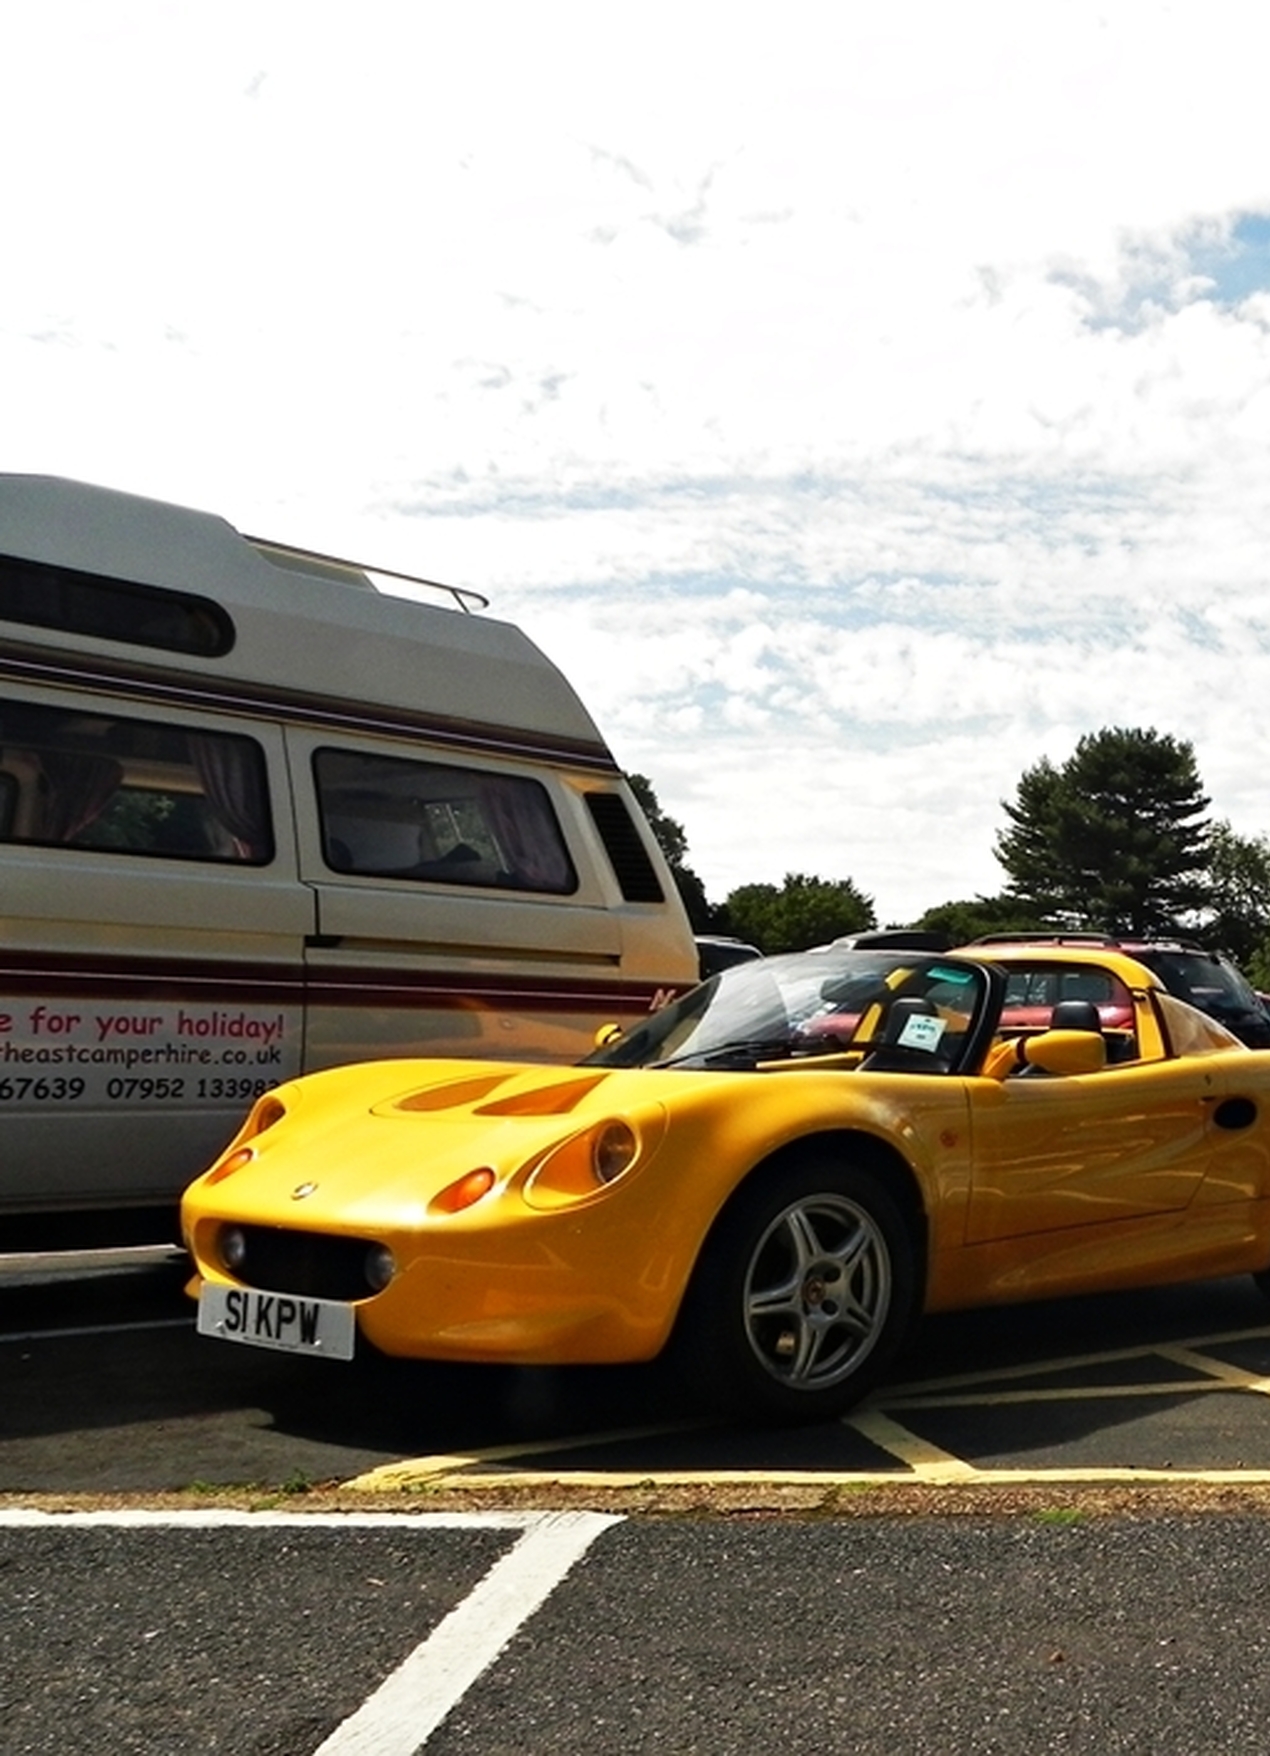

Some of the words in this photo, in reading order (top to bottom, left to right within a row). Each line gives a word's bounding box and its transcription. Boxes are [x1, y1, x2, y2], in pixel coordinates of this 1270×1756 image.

[29, 1006, 81, 1035] for
[95, 1016, 164, 1042] your
[177, 1010, 284, 1044] holiday!
[0, 1077, 85, 1100] 67639
[107, 1078, 184, 1099] 07952
[255, 1294, 320, 1345] KPW
